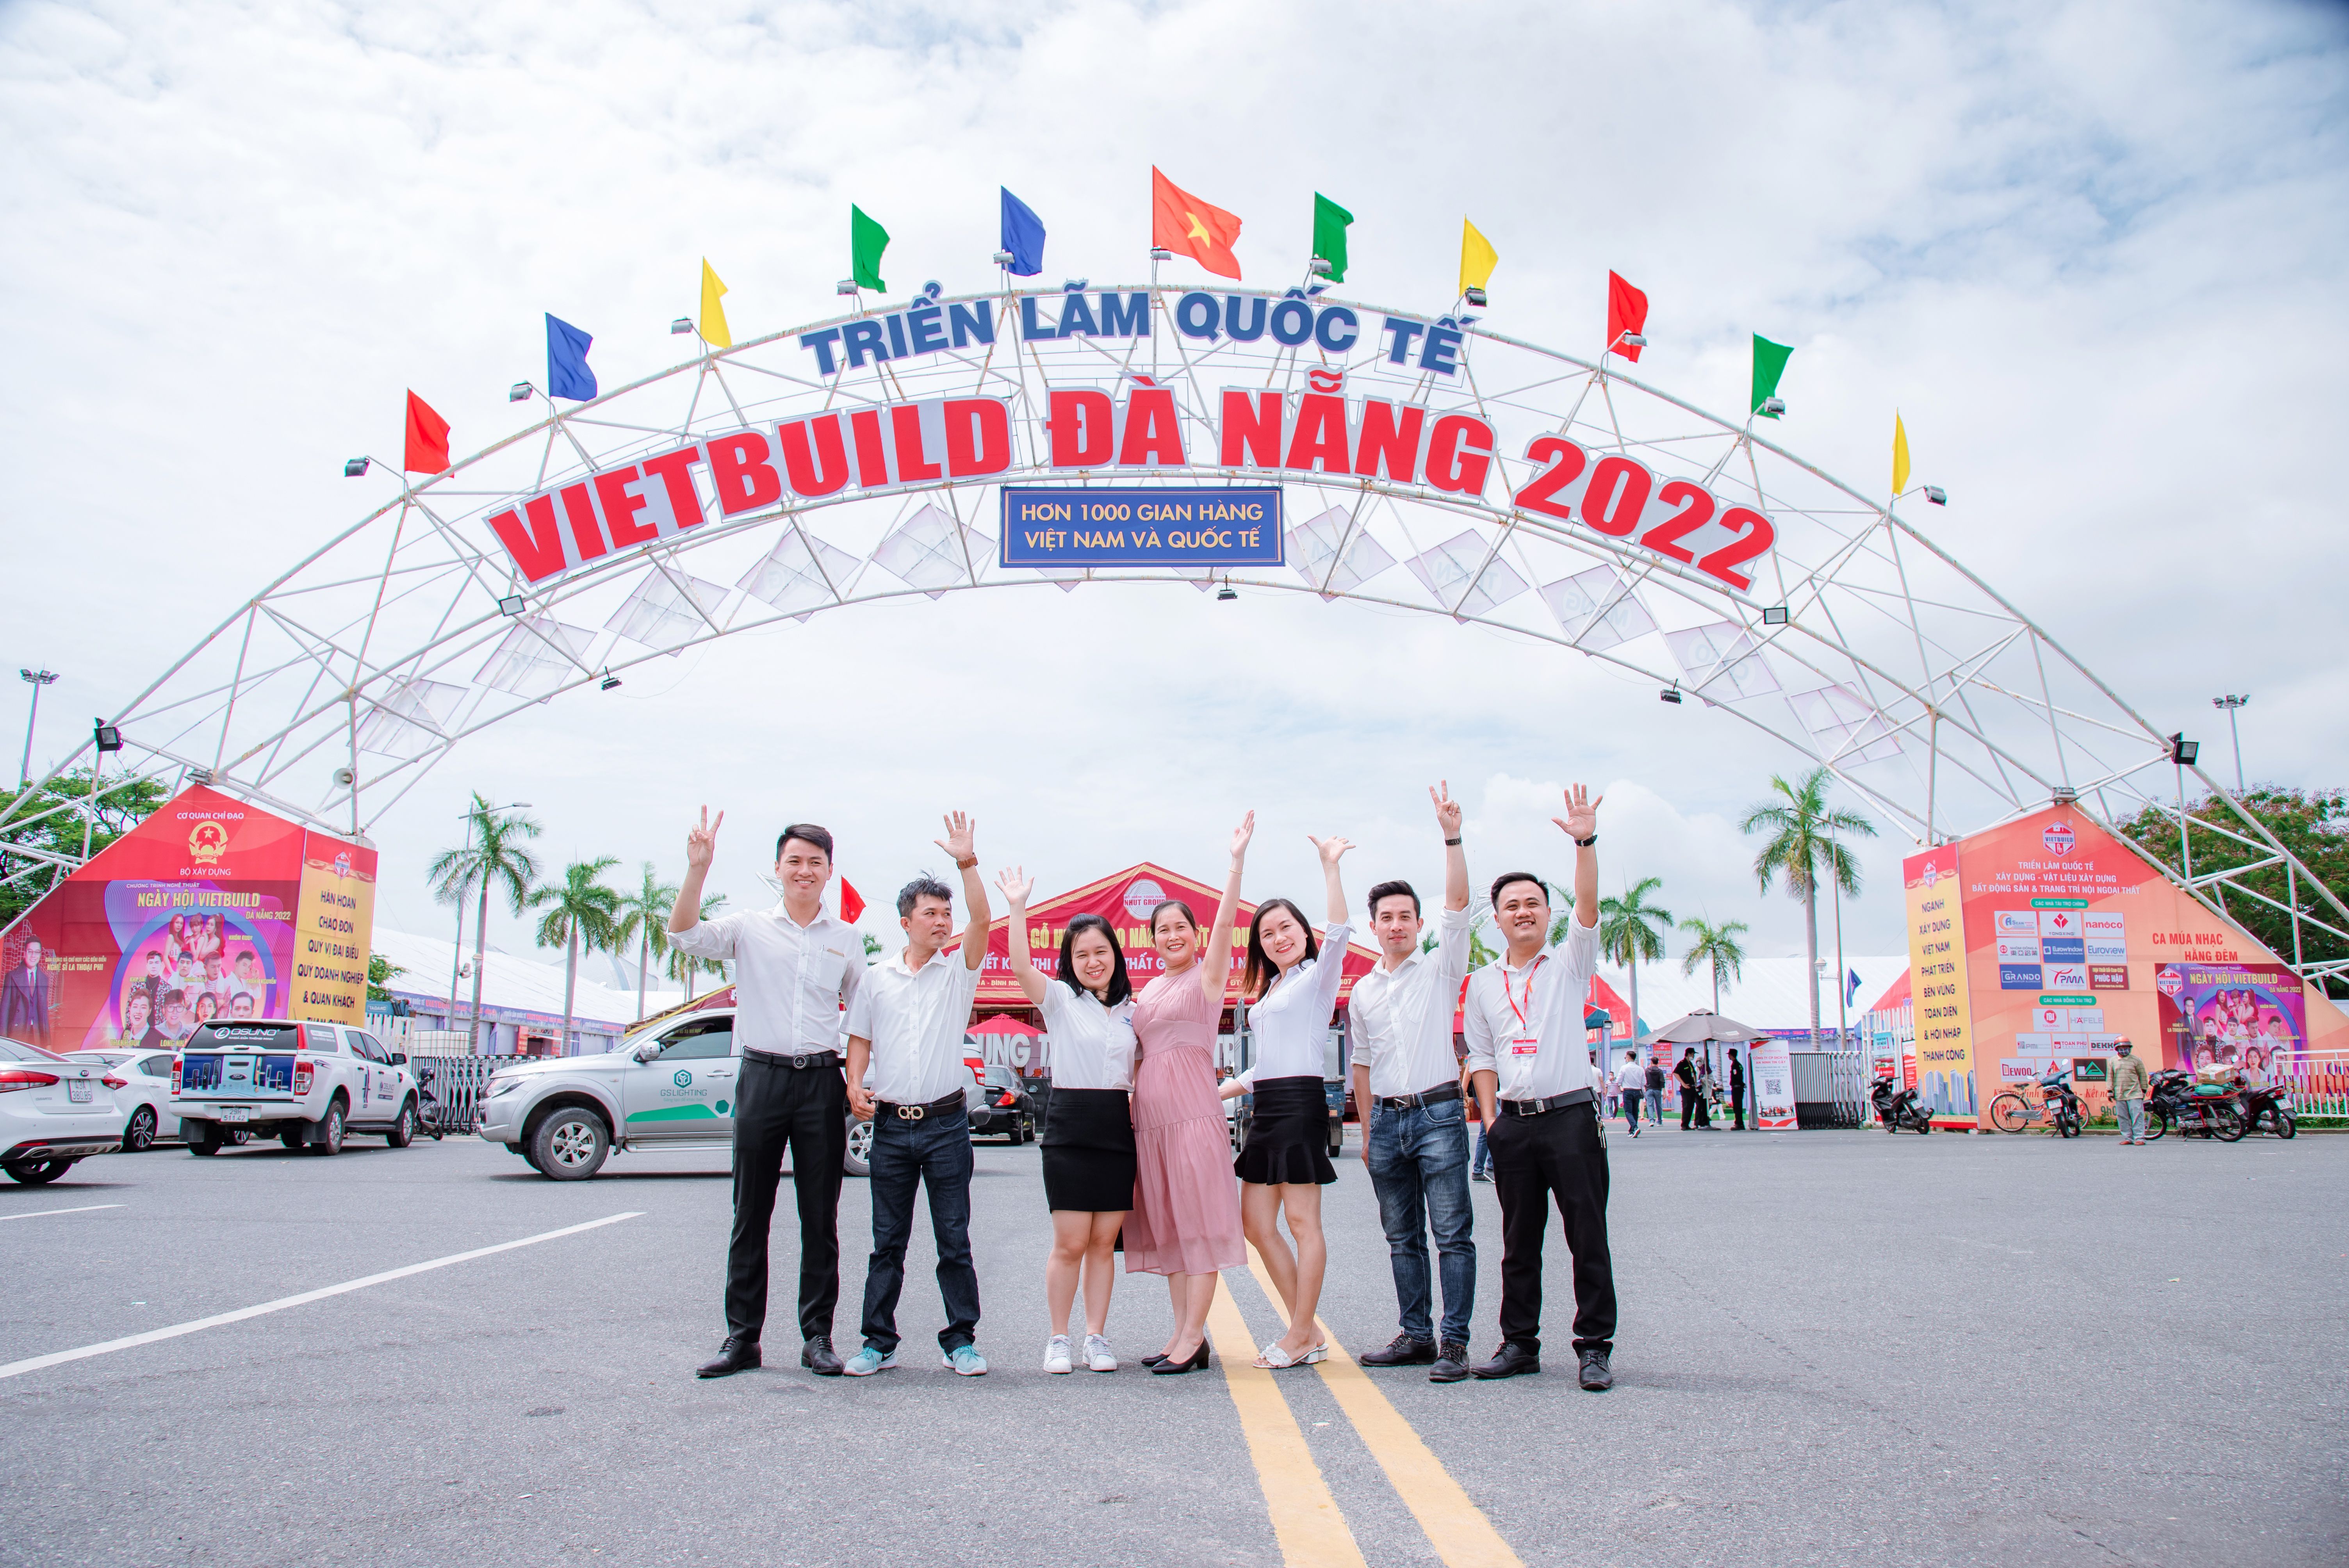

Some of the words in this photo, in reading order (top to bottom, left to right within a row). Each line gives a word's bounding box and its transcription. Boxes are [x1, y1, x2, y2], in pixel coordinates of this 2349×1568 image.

[801, 283, 994, 373] TRIỂN
[1022, 282, 1149, 339] LÃM
[1177, 286, 1356, 351] QUỐC
[1386, 317, 1474, 374] TẾ
[489, 400, 1010, 581] VIETBUILD
[1046, 376, 1185, 466] ĐÀ
[1221, 370, 1493, 495] NẴNG
[1515, 438, 1773, 590] 2022
[1022, 502, 1071, 521] HƠN
[1082, 504, 1130, 520] 1000
[1137, 504, 1191, 520] GIAN
[1199, 500, 1263, 521] HÀNG
[1025, 527, 1068, 552] VIỆT
[1074, 531, 1124, 547] NAM
[1131, 526, 1161, 547] VÀ
[1168, 526, 1232, 549] QUỐC
[1239, 525, 1262, 547] TẾ
[212, 811, 225, 819] CHỈ
[227, 812, 244, 821] ĐẠO
[180, 867, 191, 877] BỘ
[208, 868, 231, 877] DỰNG
[2018, 859, 2041, 869] TRIỂN
[2043, 861, 2060, 870] LÃM
[2062, 860, 2083, 871] QUỐC
[2085, 861, 2094, 871] TẾ
[2014, 873, 2035, 882] DỰNG
[2043, 873, 2058, 882] VẬT
[2060, 873, 2077, 883] LIỆU
[2079, 873, 2094, 882] XÂY
[2096, 875, 2117, 884] DỰNG
[1972, 882, 1987, 892] BẤT
[1989, 884, 2011, 894] ĐỘNG
[2014, 883, 2029, 893] SẢN
[2068, 884, 2080, 893] TRÍ
[2082, 884, 2094, 894] NỘI
[2097, 886, 2119, 896] NGOẠI
[2121, 884, 2140, 894] THẤT
[138, 889, 169, 907] NGÀY
[173, 889, 194, 910] HỘI
[198, 893, 260, 907] VIETBUILD
[337, 894, 356, 910] HOAN
[246, 910, 255, 919] ĐÀ
[274, 911, 291, 920] 2022
[339, 918, 354, 934] ĐÓN
[1919, 922, 1931, 935] XÂY
[1932, 919, 1951, 934] DỰNG
[1030, 922, 1049, 948] GỖ
[2152, 933, 2166, 944] CA
[2169, 931, 2192, 945] MÚA
[2196, 934, 2223, 948] NHẠC
[325, 942, 331, 958] VỊ
[333, 943, 344, 959] ĐẠI
[346, 942, 359, 960] BIỂU
[1922, 942, 1934, 956] VIỆT
[1935, 941, 1951, 953] NAM
[2087, 945, 2125, 954] Euroview
[2215, 948, 2238, 961] ĐÊM
[77, 964, 93, 972] THOẠI
[1032, 958, 1051, 970] THI
[1921, 963, 1936, 976] PHÁT
[1937, 958, 1955, 973] TRIỂN
[314, 966, 339, 981] DOANH
[341, 970, 364, 987] NGHIỆP
[2094, 973, 2110, 982] PHÚC
[2111, 974, 2123, 984] HẬU
[2189, 971, 2213, 984] NGÀY
[2215, 970, 2232, 987] HỘI
[2234, 973, 2278, 984] VIETBUILD
[303, 991, 308, 1003] &
[311, 991, 331, 1006] QUAN
[333, 992, 355, 1009] KHÁCH
[1924, 1005, 1942, 1019] TOÀN
[1943, 1003, 1958, 1019] DIỆN
[1924, 1030, 1928, 1040] &
[1930, 1027, 1942, 1041] HỘI
[1943, 1025, 1961, 1040] NHẬP
[1923, 1048, 1944, 1062] THÀNH
[1946, 1047, 1965, 1061] CÔNG
[76, 1080, 86, 1089] 43A
[2085, 1085, 2098, 1098] Kết
